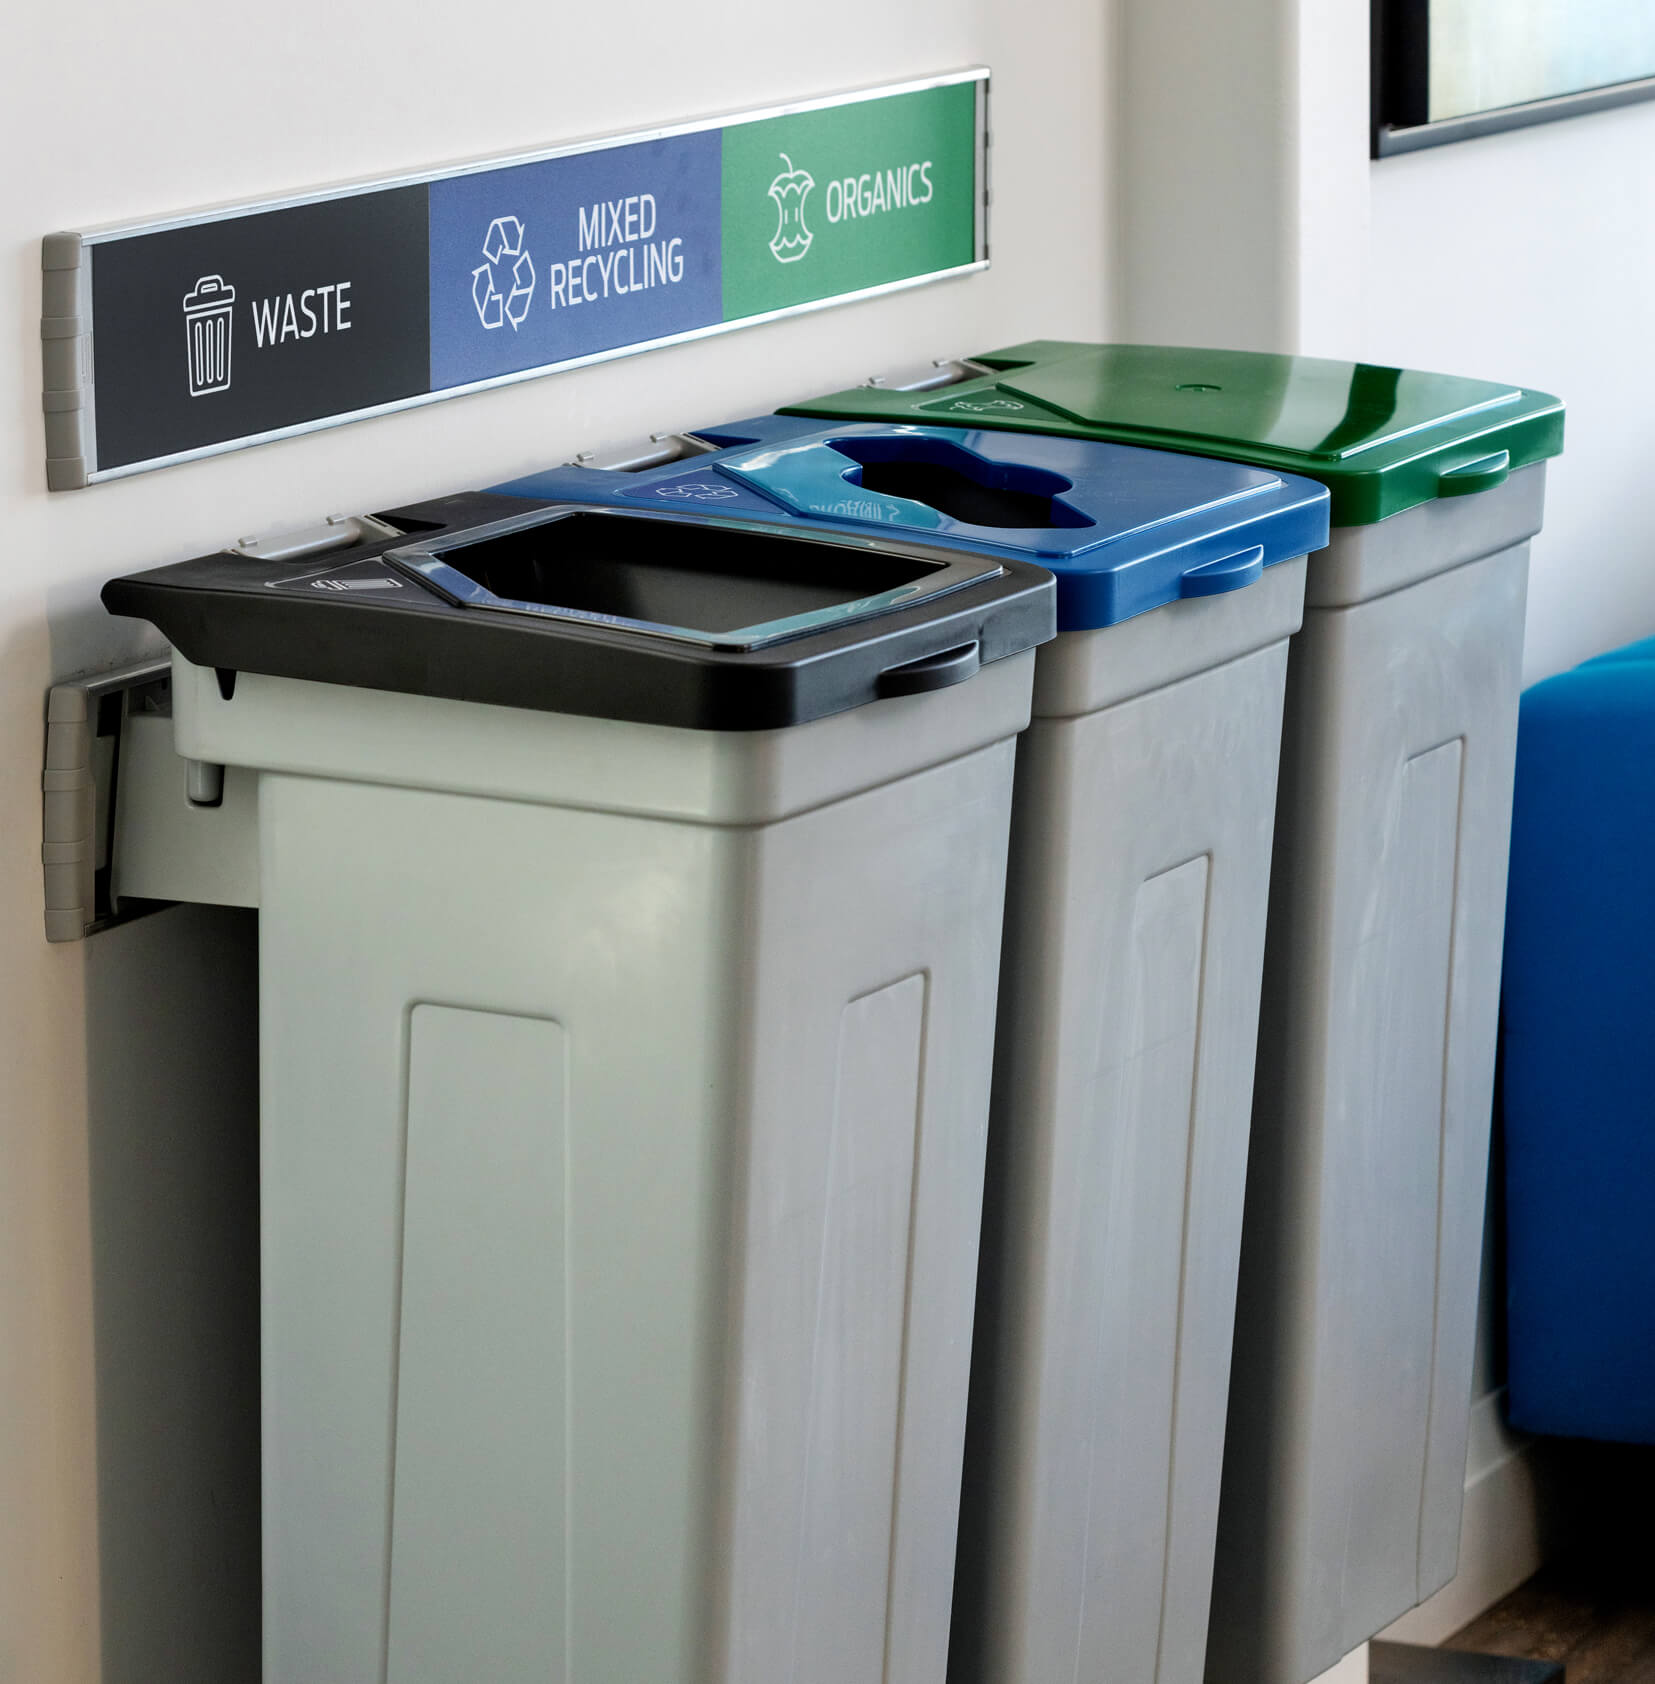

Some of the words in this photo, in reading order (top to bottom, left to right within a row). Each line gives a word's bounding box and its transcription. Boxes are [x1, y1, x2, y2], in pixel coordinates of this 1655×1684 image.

[579, 193, 656, 252] MIXED
[826, 161, 933, 223] ORGANICS
[550, 237, 684, 310] RECYCLING
[251, 281, 352, 348] WASTE
